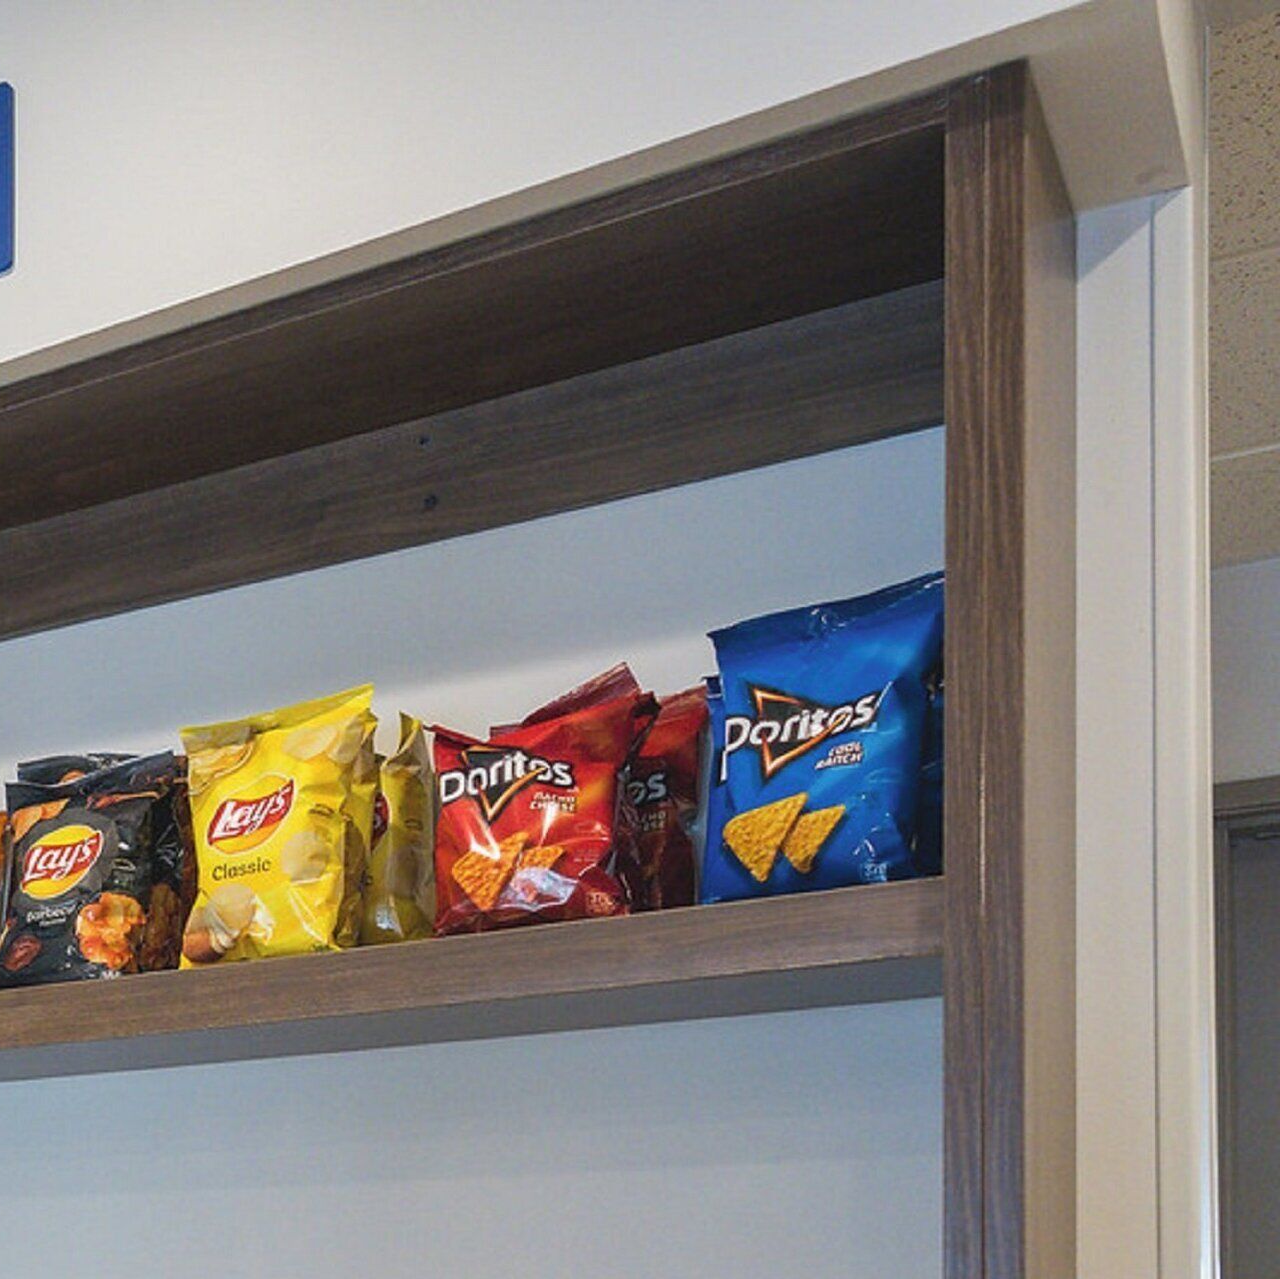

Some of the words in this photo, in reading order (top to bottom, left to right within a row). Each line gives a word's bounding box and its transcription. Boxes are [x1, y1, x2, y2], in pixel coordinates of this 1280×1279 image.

[721, 688, 885, 780] Doritos
[440, 751, 574, 803] Doritos
[24, 837, 98, 881] Lay's
[212, 856, 271, 882] Classic
